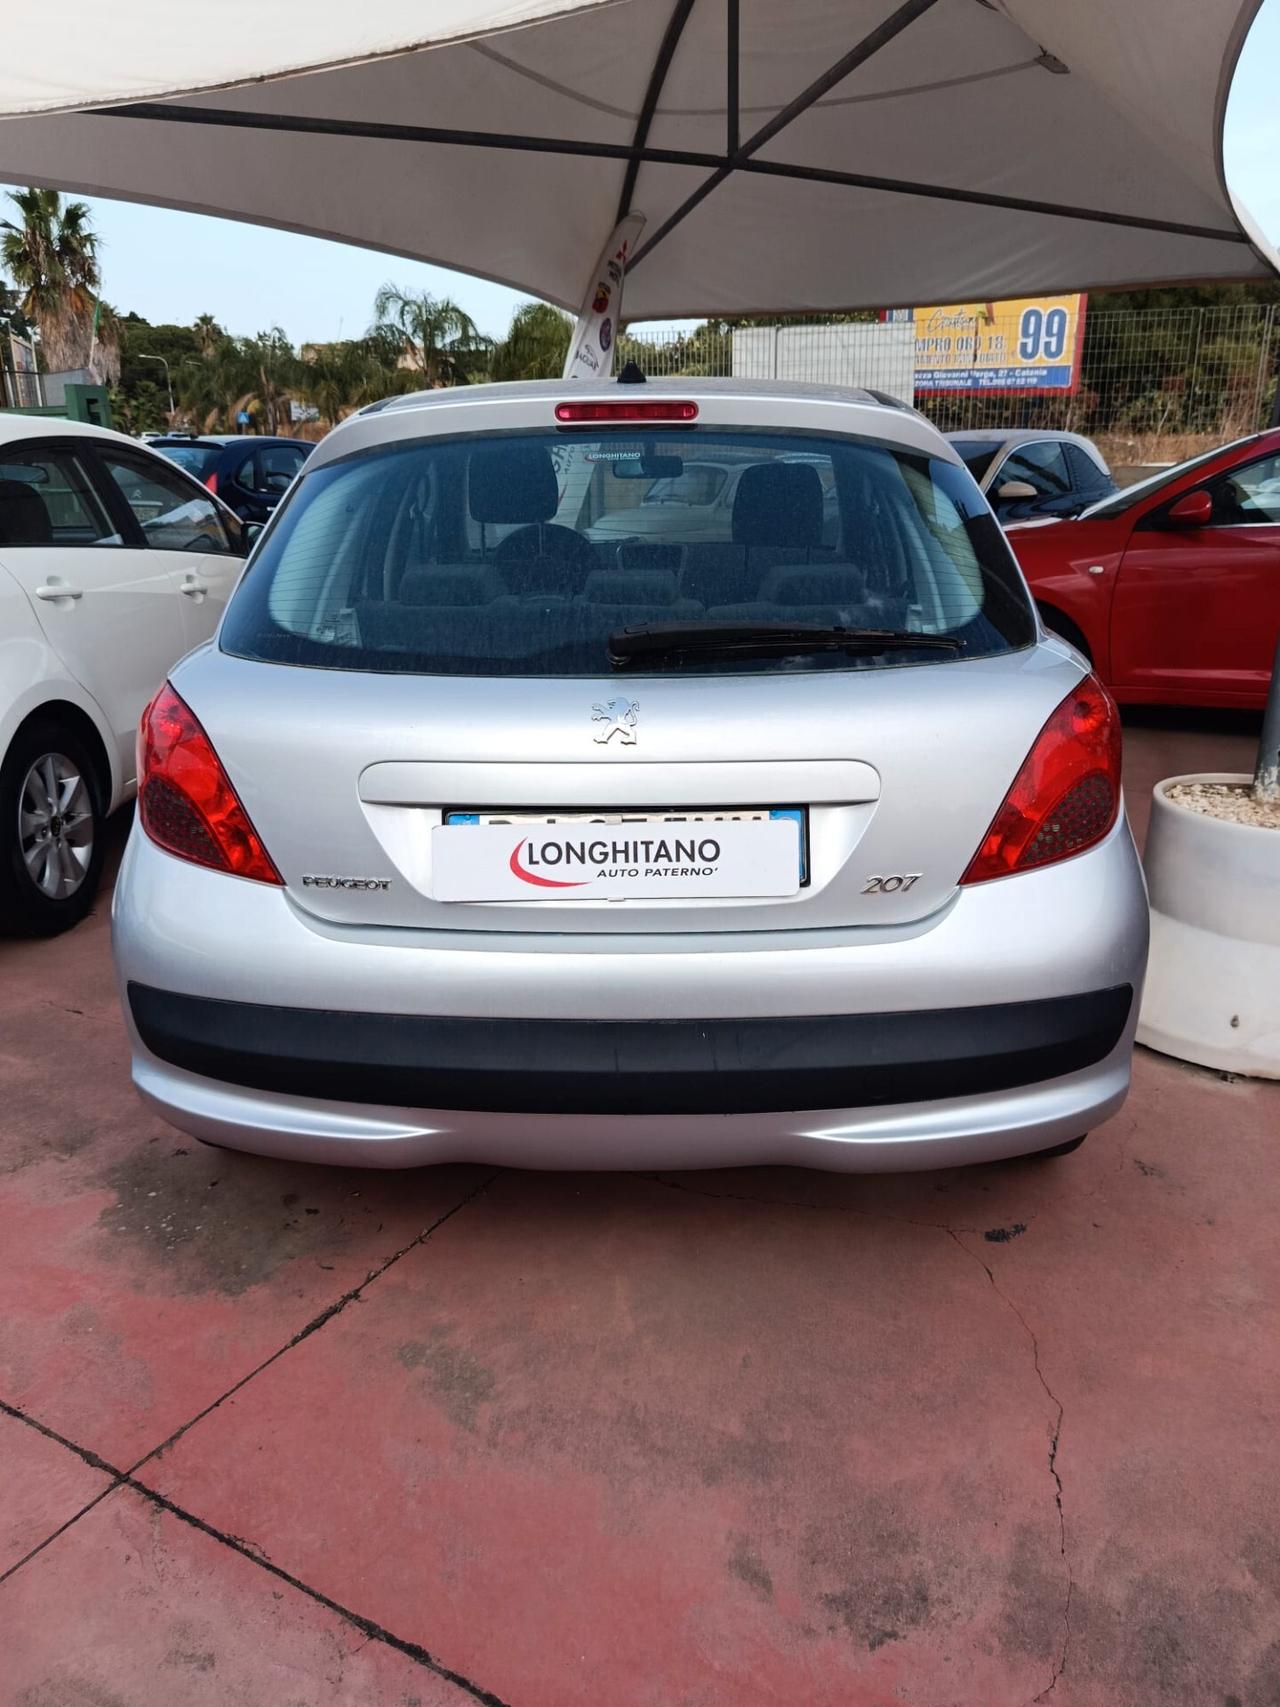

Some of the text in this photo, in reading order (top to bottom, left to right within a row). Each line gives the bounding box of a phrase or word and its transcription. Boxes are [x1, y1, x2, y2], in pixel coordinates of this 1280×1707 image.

[1019, 307, 1068, 361] 99
[528, 839, 720, 865] LONGHITANO
[301, 874, 392, 891] PEUGEOT
[597, 868, 639, 878] AUTO
[860, 872, 924, 895] 207
